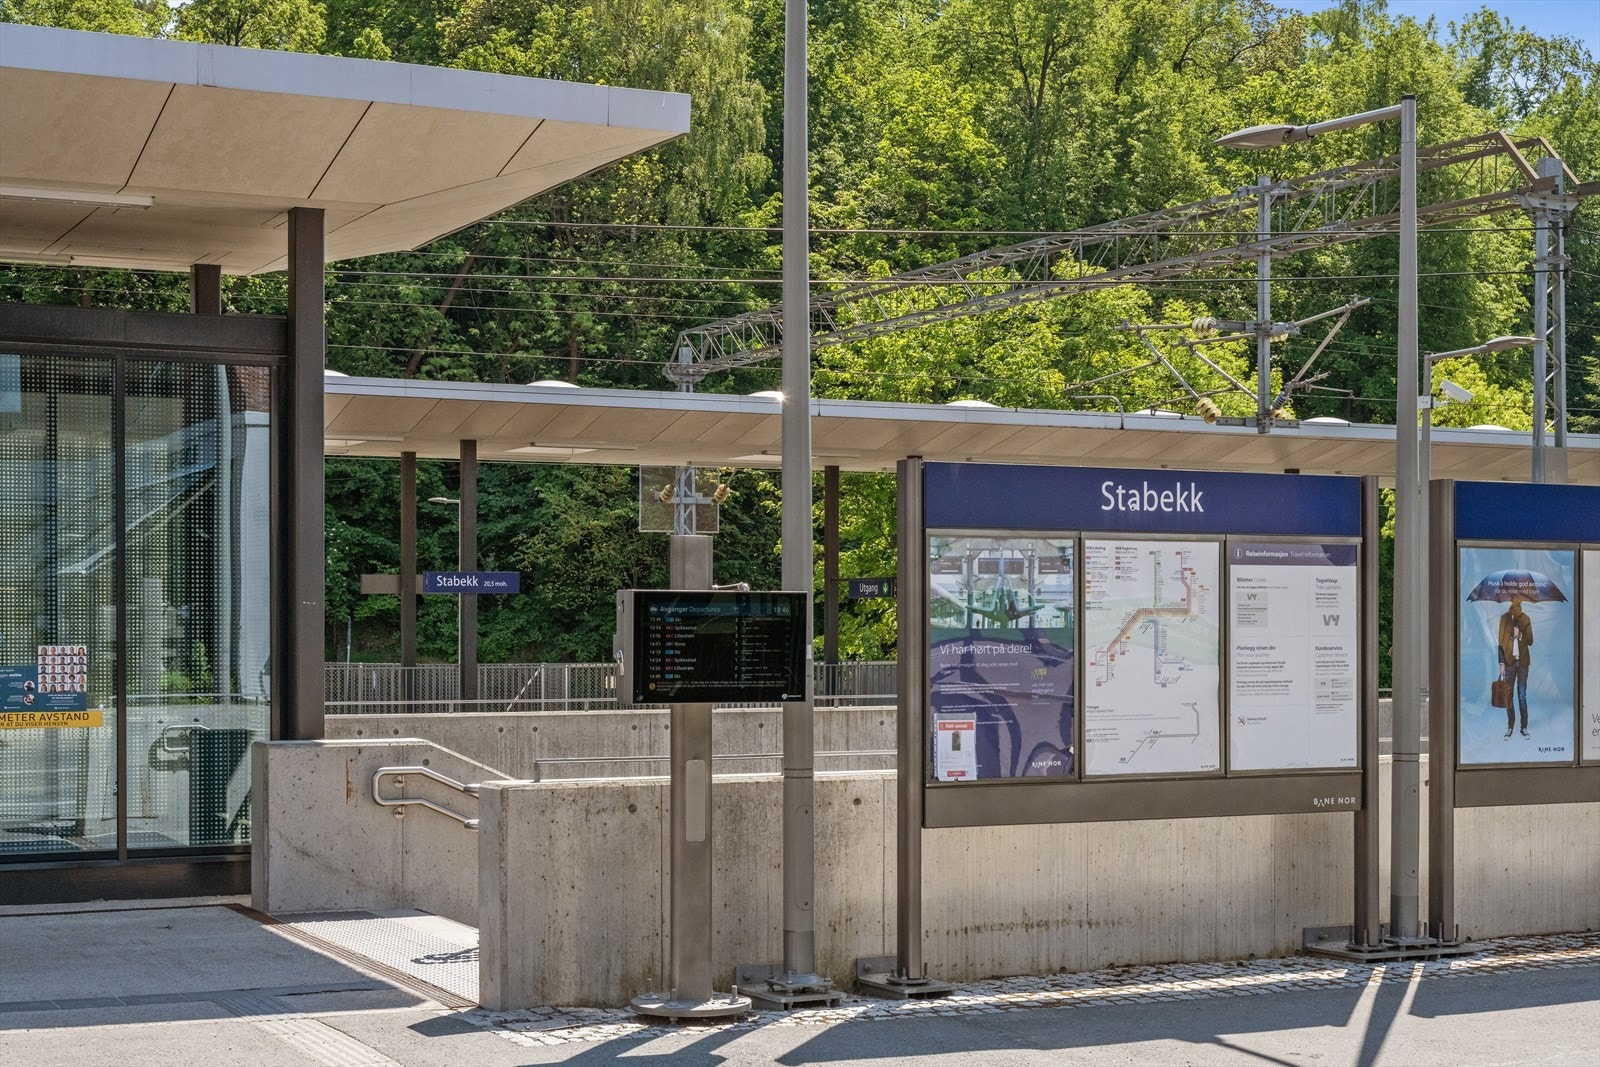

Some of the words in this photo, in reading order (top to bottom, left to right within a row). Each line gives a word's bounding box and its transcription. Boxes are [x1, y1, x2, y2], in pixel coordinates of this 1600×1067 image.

[1101, 481, 1204, 512] Stabekk
[436, 575, 478, 586] Stabekk
[860, 583, 878, 594] Utgang
[940, 644, 949, 654] Vi
[951, 644, 967, 654] har
[970, 644, 991, 654] hørt
[993, 643, 1004, 656] på
[1007, 643, 1032, 654] dere!
[0, 713, 35, 722] METER
[40, 713, 89, 721] AVSTAND
